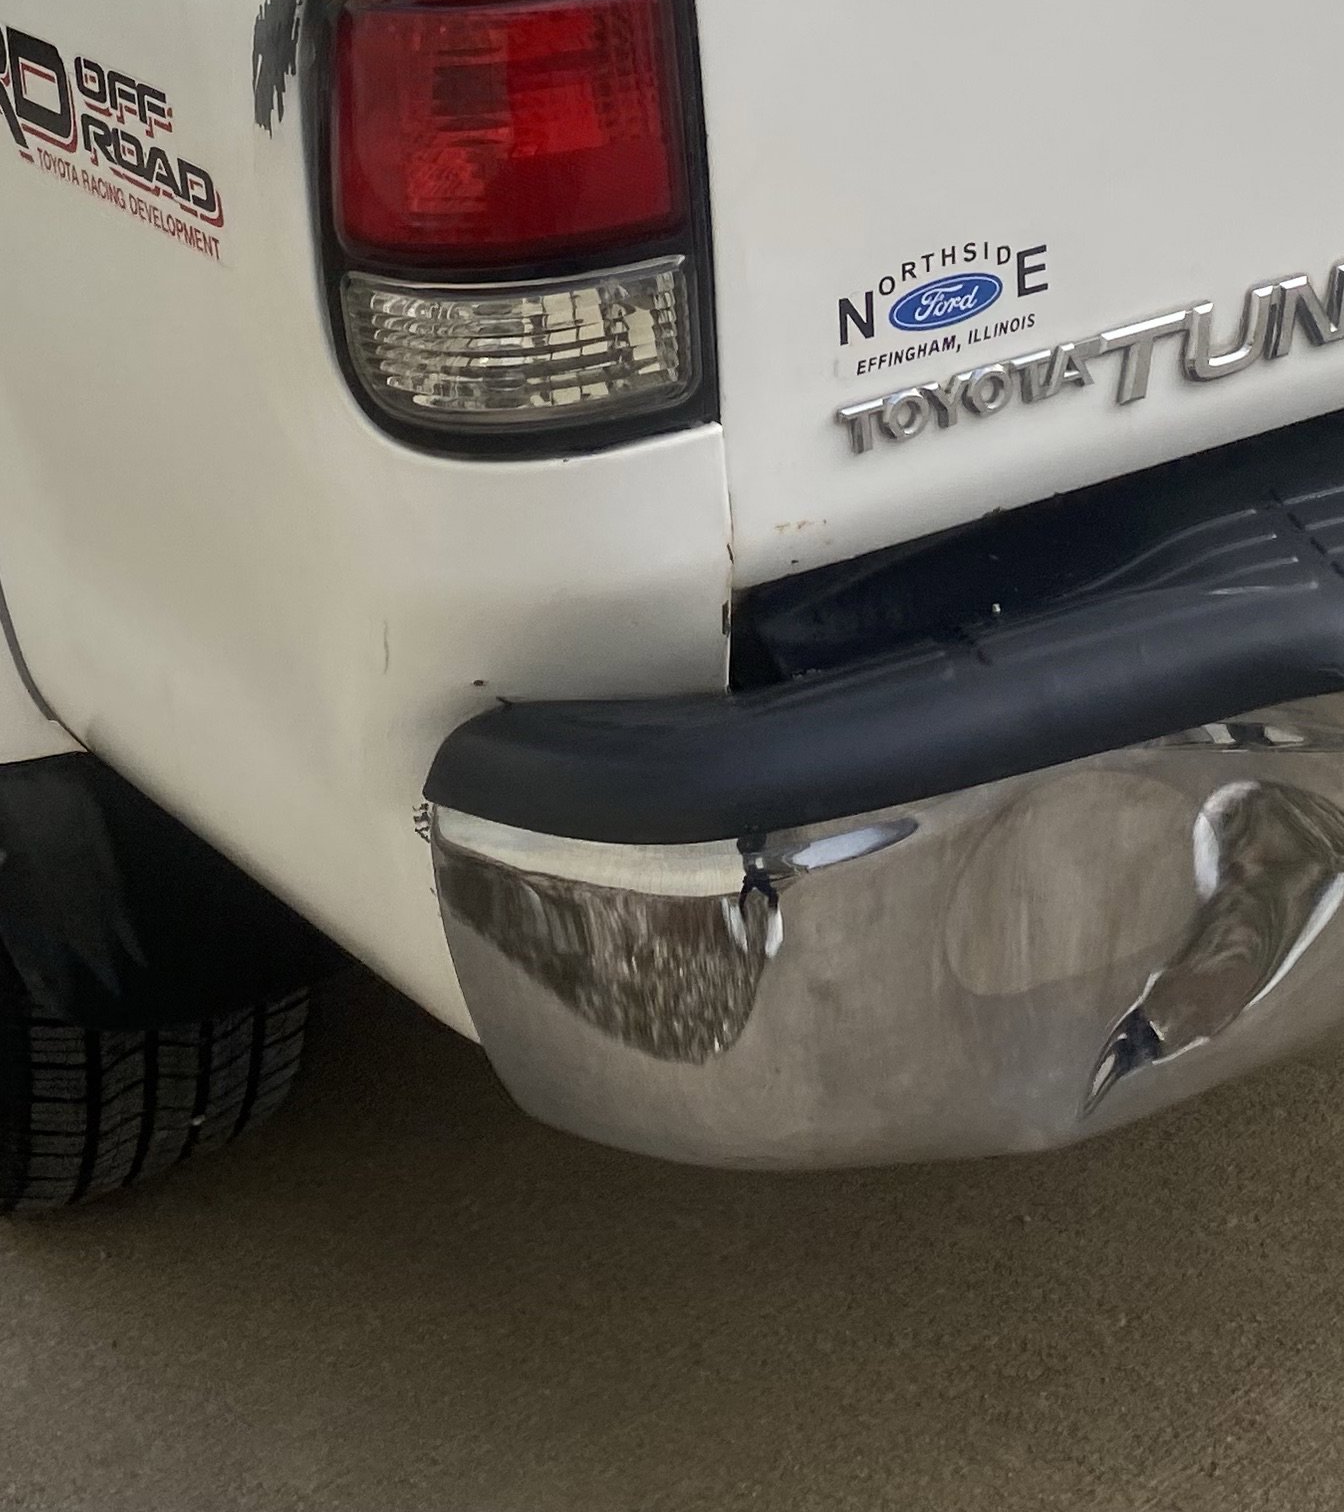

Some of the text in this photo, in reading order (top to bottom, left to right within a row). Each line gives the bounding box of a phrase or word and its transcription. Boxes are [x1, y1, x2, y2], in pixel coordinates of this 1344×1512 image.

[74, 56, 173, 138] OFF
[36, 147, 222, 261] TOYOTA RACING DEVELOPMENT
[80, 112, 224, 228] ROAD
[838, 241, 1049, 346] NORTHSIDE
[855, 313, 1036, 376] EFFINGHAM, ILLINOIS
[914, 284, 980, 322] Ford
[837, 341, 1096, 455] TOYOTA
